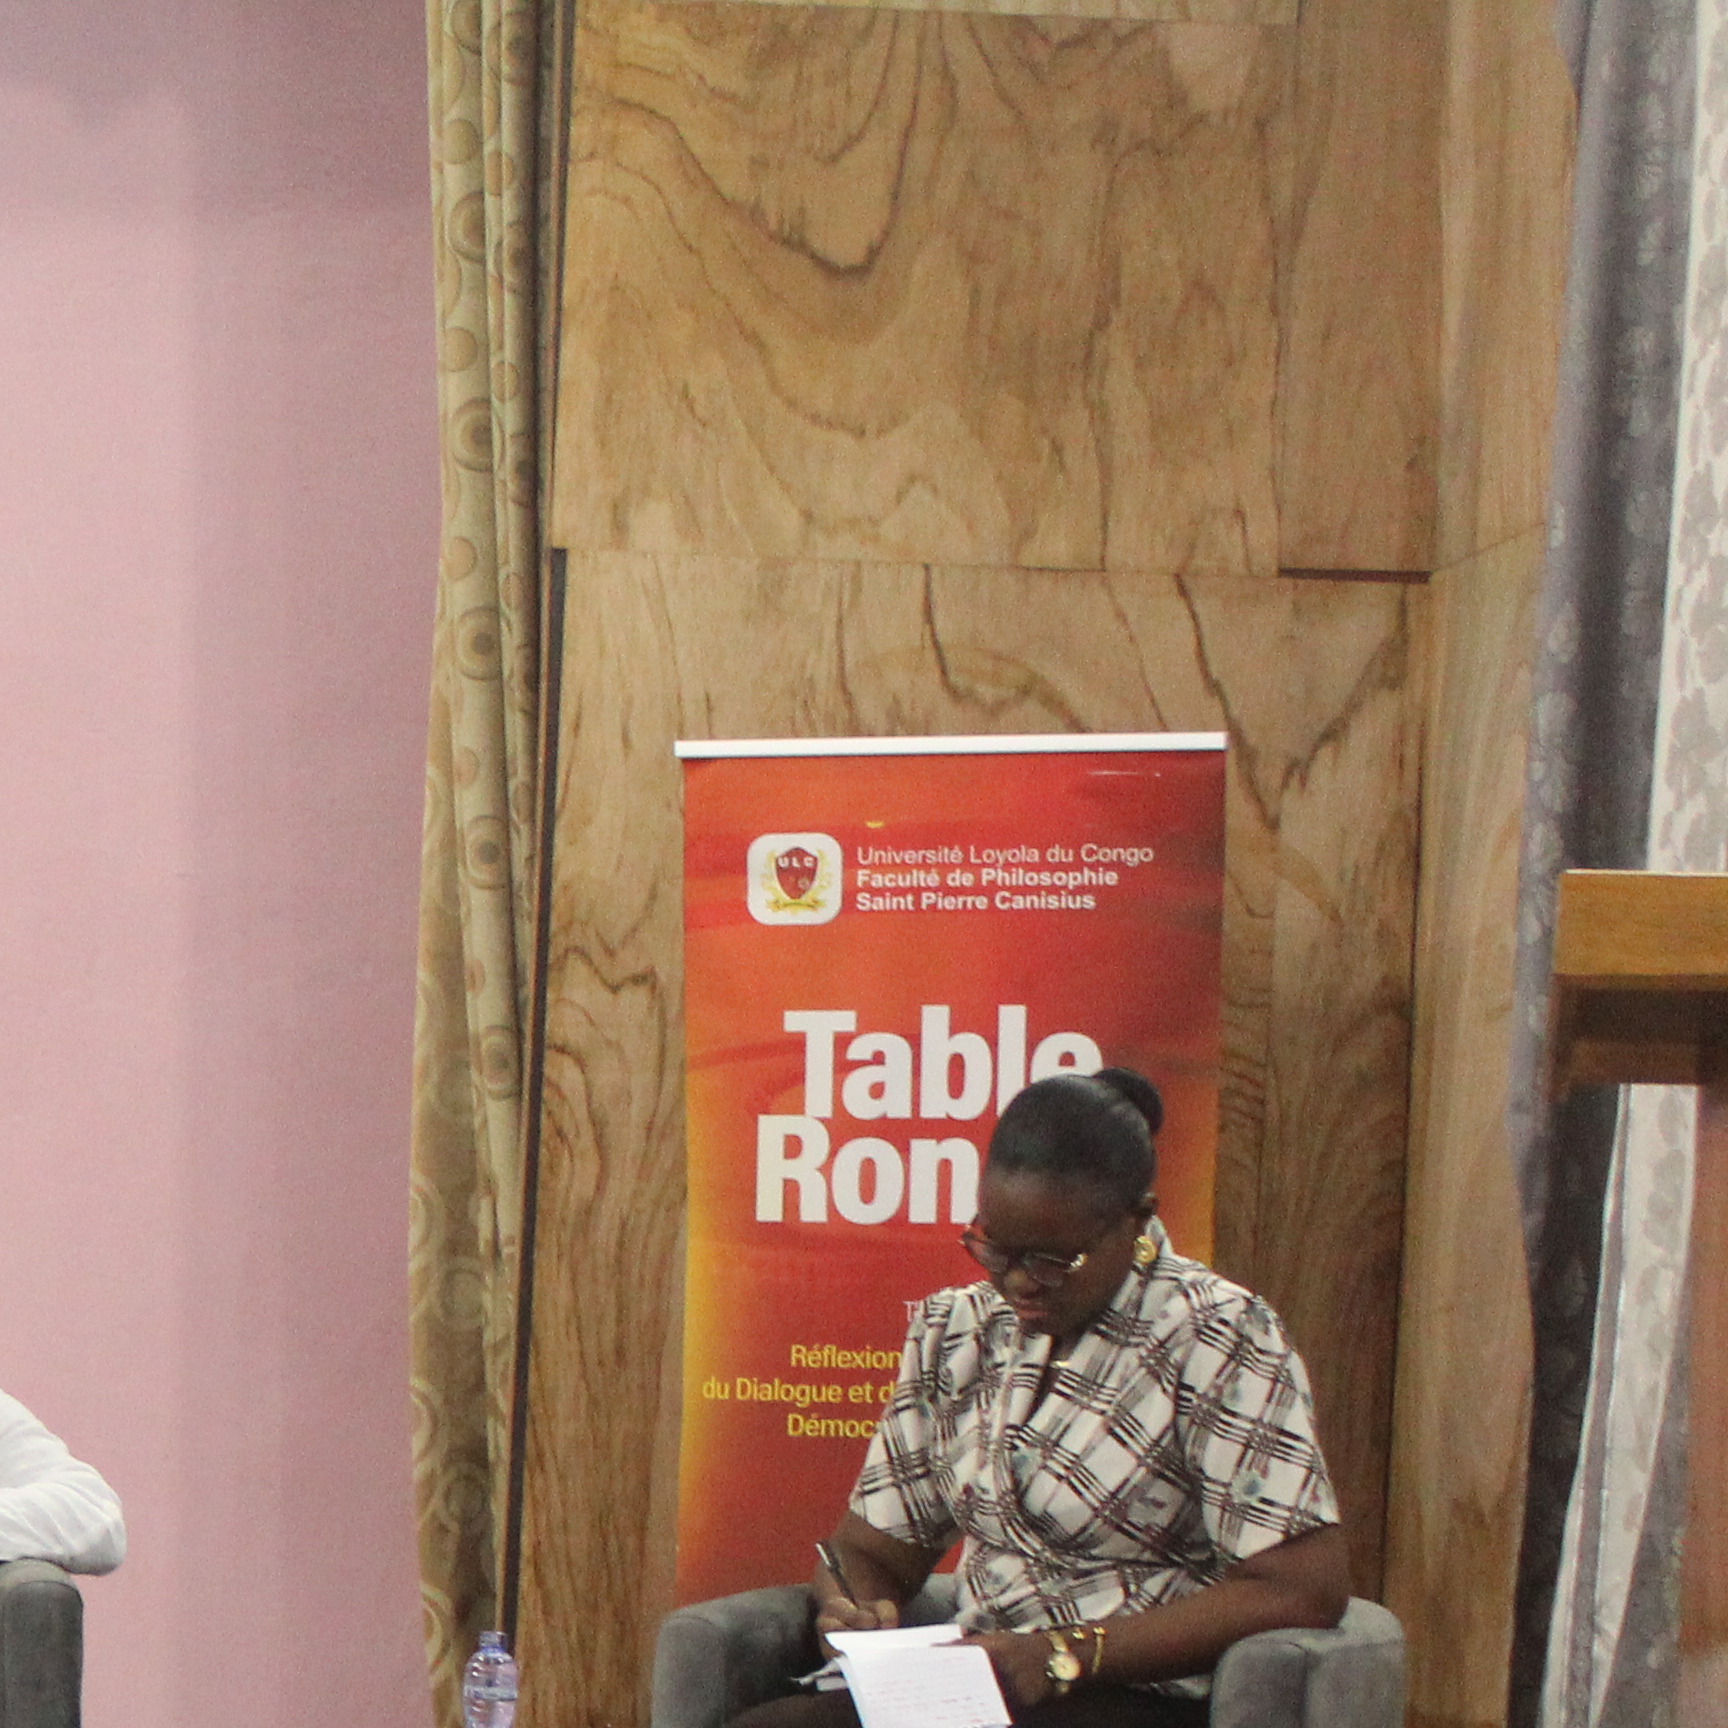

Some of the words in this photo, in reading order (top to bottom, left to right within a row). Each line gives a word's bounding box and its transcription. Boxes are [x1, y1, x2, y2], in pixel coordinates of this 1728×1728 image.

[856, 845, 964, 866] Université
[969, 845, 1040, 868] Loyola
[1046, 843, 1074, 863] du
[1080, 842, 1155, 867] Congo
[856, 868, 941, 888] Faculté
[946, 868, 975, 887] de
[981, 867, 1119, 890] Philosophie
[855, 891, 915, 912] Saint
[920, 890, 989, 911] Pierre
[994, 890, 1097, 911] Canisius
[702, 1375, 731, 1400] du
[735, 1376, 843, 1408] Dialogue
[848, 1381, 873, 1404] et
